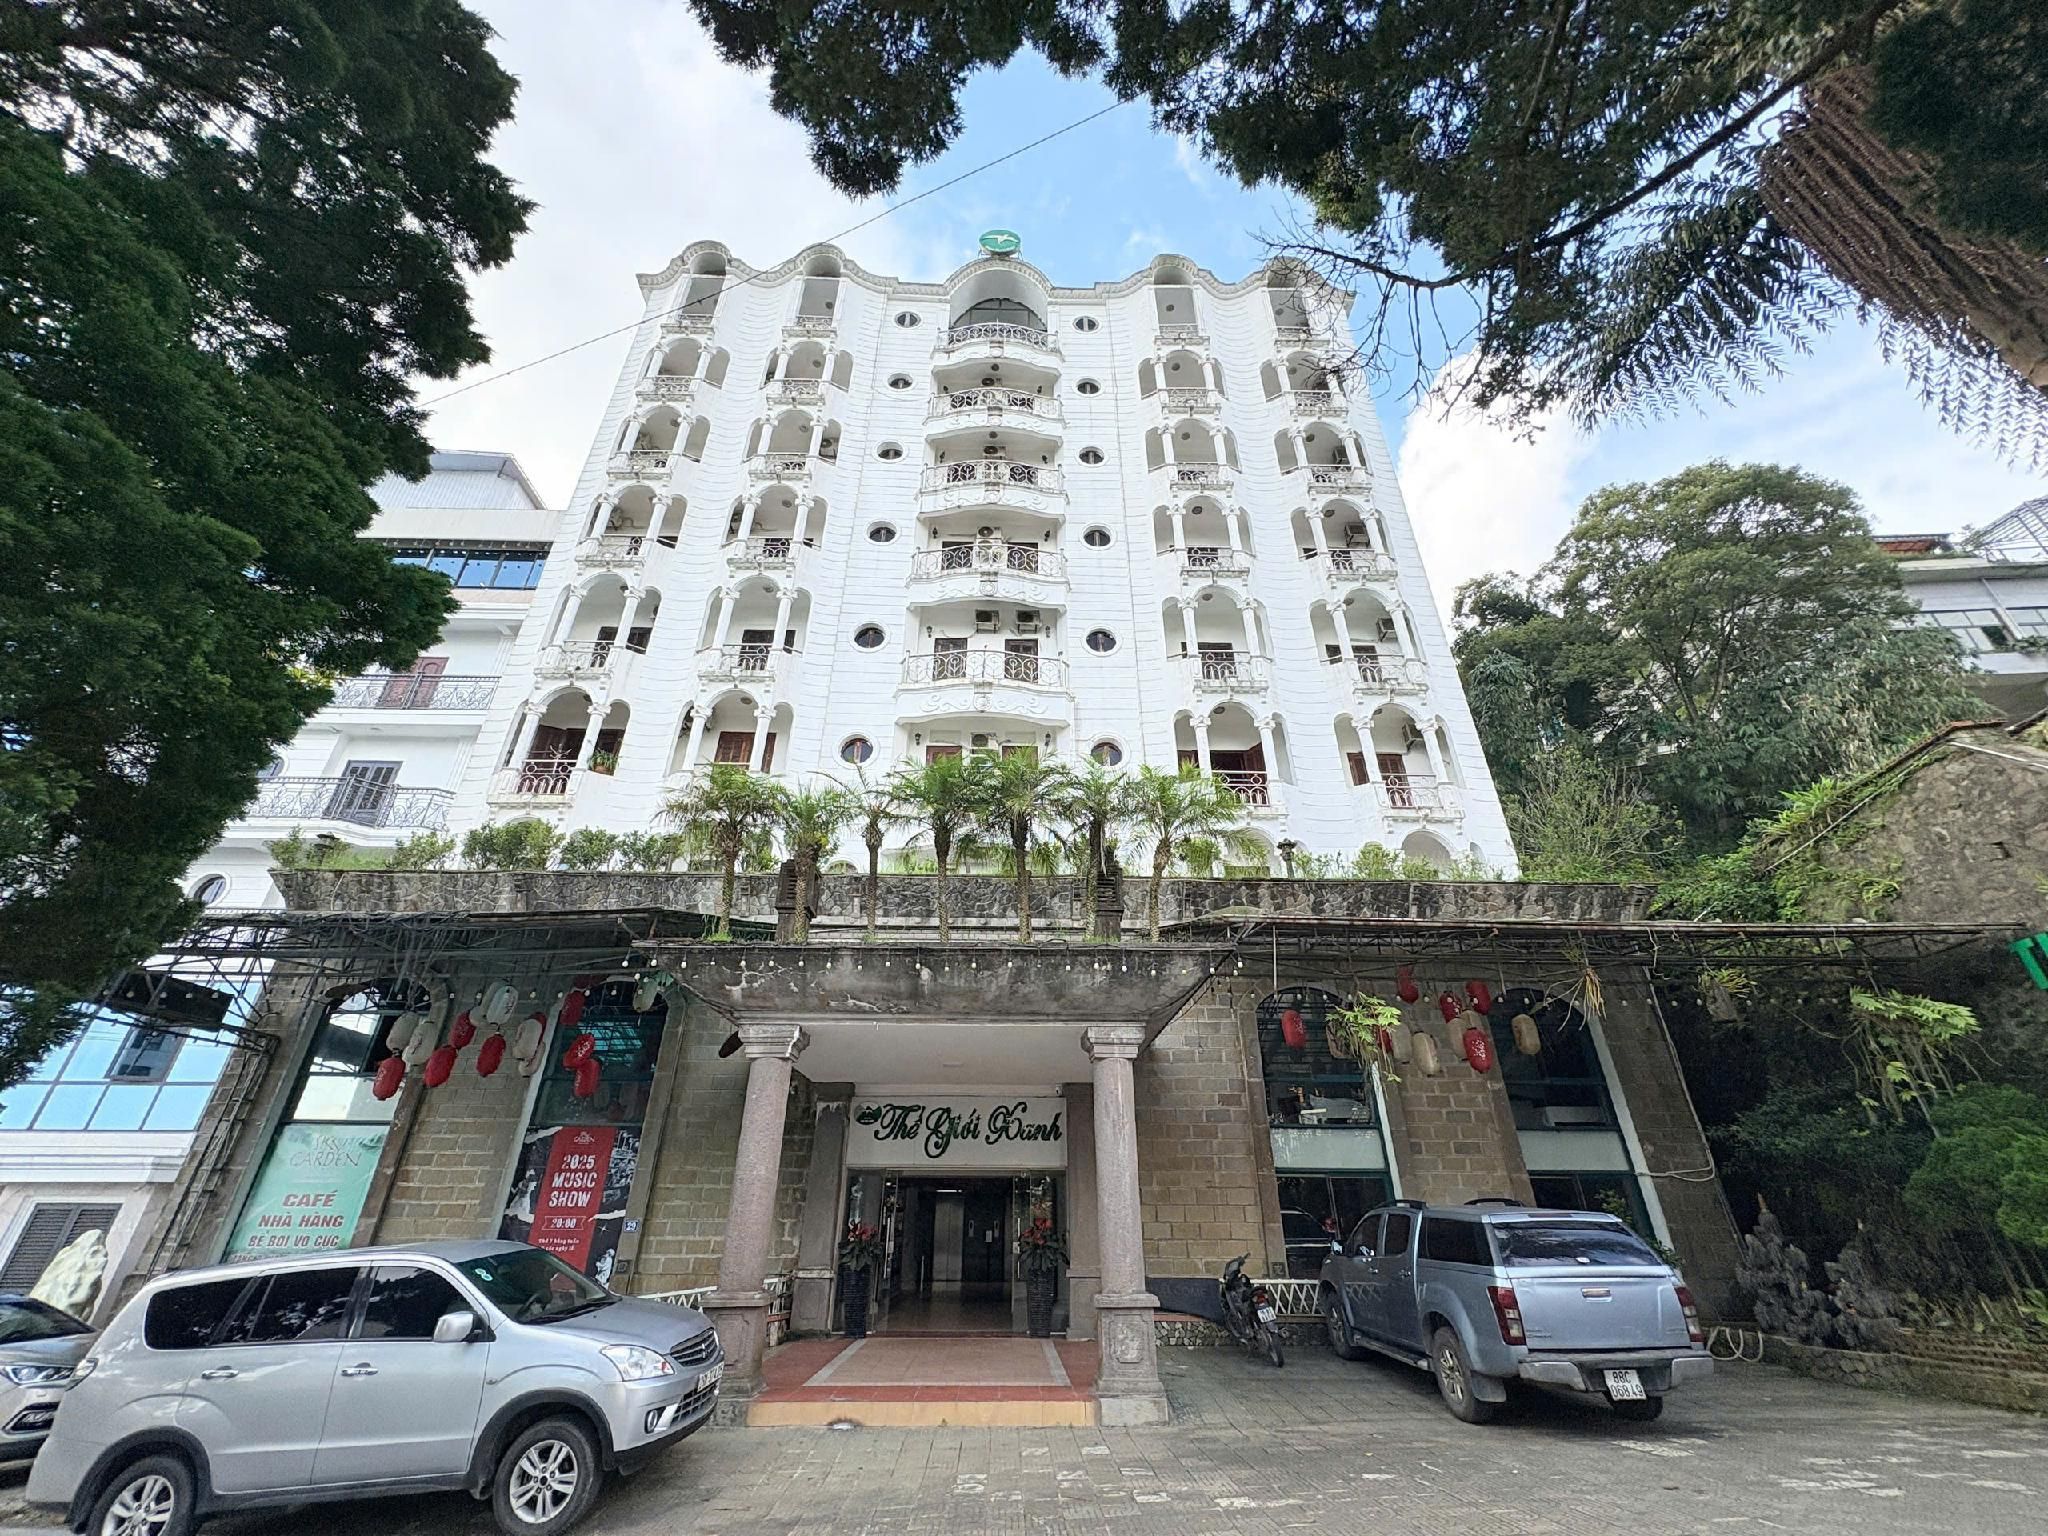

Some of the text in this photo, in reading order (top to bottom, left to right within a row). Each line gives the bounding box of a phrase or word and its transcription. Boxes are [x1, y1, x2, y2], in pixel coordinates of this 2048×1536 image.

[874, 1101, 1063, 1158] Thế Giới Xanh
[561, 1154, 596, 1170] 2025
[552, 1172, 598, 1188] MUSIC
[283, 1189, 338, 1207] CAFÉ
[548, 1190, 592, 1207] SHOW
[258, 1211, 344, 1227] NHÀ HÀNG
[550, 1218, 577, 1229] 20:00
